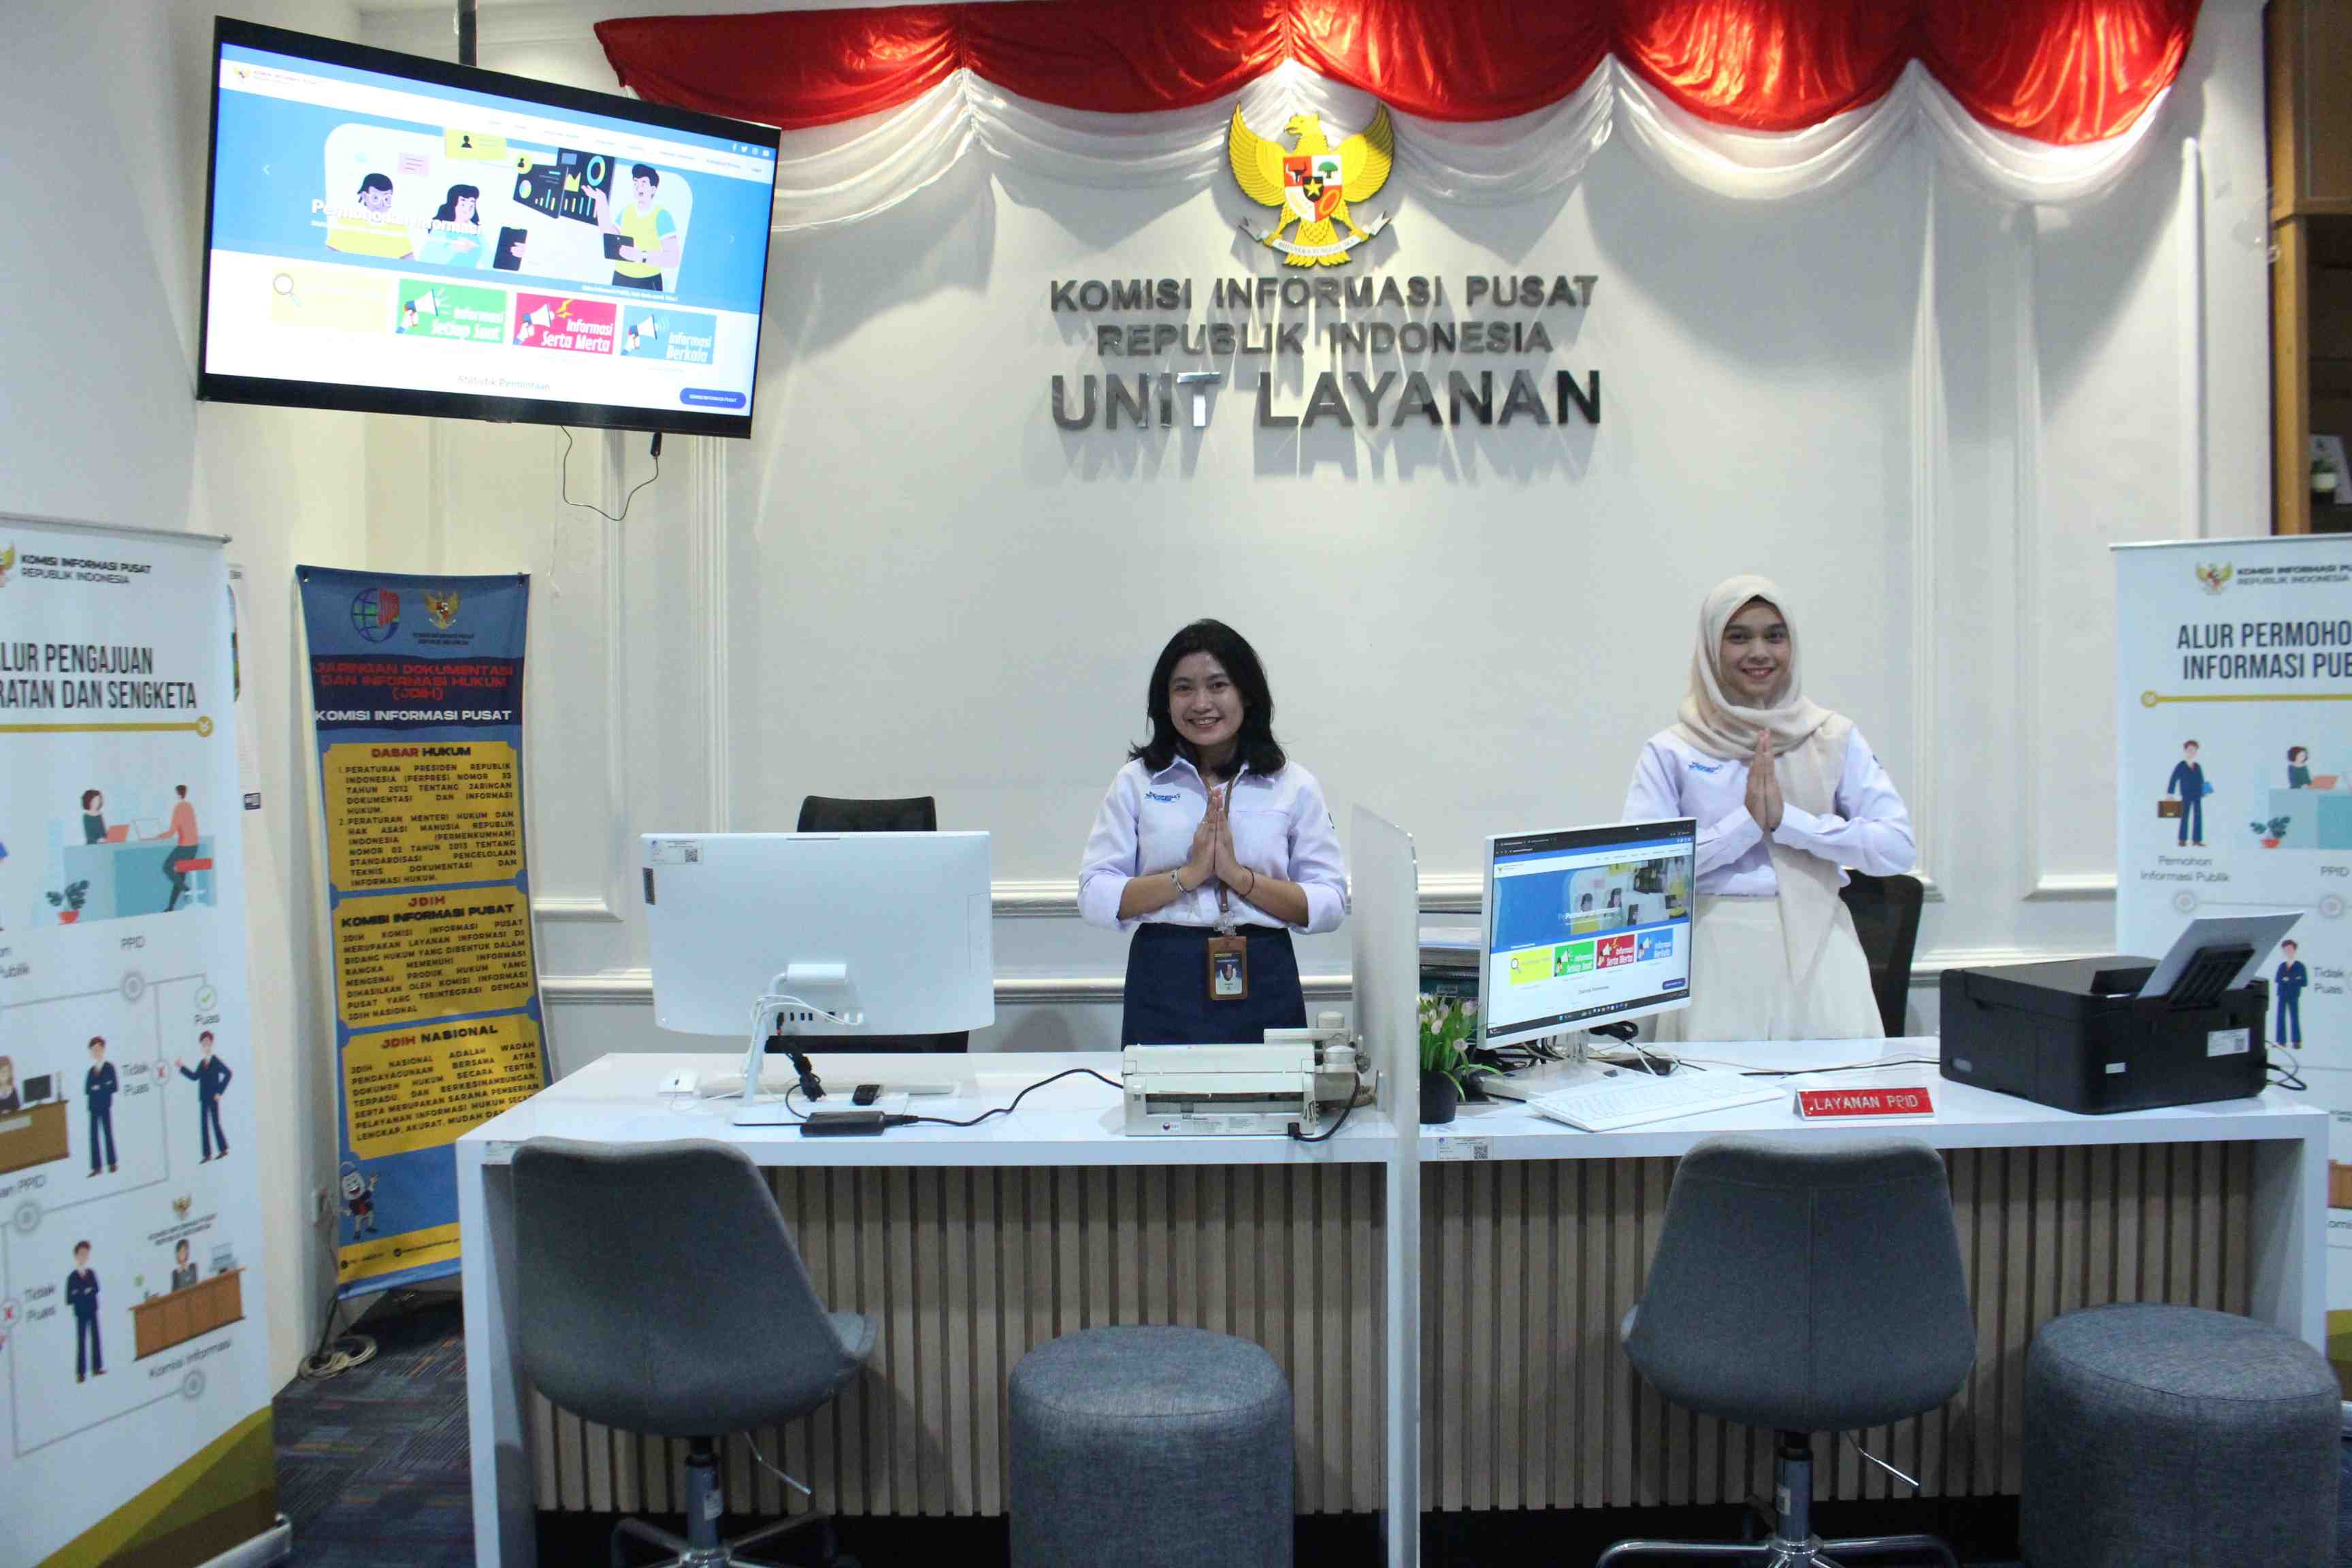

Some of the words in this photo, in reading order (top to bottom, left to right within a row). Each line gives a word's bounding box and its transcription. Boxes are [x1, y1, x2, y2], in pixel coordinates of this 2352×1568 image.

[1051, 278, 1192, 311] KOMISI
[1215, 275, 1442, 309] INFORMASI
[1466, 275, 1599, 308] PUSAT
[566, 318, 613, 336] Informasi
[541, 331, 572, 348] Serta
[575, 334, 610, 352] Merta
[668, 332, 712, 348] Informasi
[1097, 322, 1304, 356] REPUBLIK
[1329, 321, 1553, 355] INDONESIA
[1051, 372, 1220, 429] UNIT
[1258, 370, 1600, 428] LAYANAN
[20, 555, 58, 566] KOMISI
[61, 558, 117, 570] INFORMASI
[120, 564, 152, 574] PUSAT
[2237, 567, 2274, 575] KOMISI
[2277, 565, 2336, 574] INFORMASI
[21, 568, 74, 580] REPUBLIK
[76, 571, 130, 584] INDONESIA
[2177, 624, 2233, 649] ALUR
[2241, 621, 2352, 647] PERMOHO
[0, 642, 38, 672] LUR
[45, 644, 152, 674] PENGAJUAN
[2183, 654, 2304, 680] INFORMASI
[2313, 653, 2352, 678] PUB
[63, 681, 102, 708] DAN
[108, 681, 197, 708] SENGKETA
[314, 710, 370, 721] KOMISI
[375, 710, 458, 721] INFORMASI
[462, 710, 512, 720] PUSAT
[2321, 866, 2349, 877] PPID
[421, 1025, 497, 1043] NASIONAL
[1814, 1096, 1880, 1111] LAYANAN
[1886, 1094, 1918, 1108] PPID
